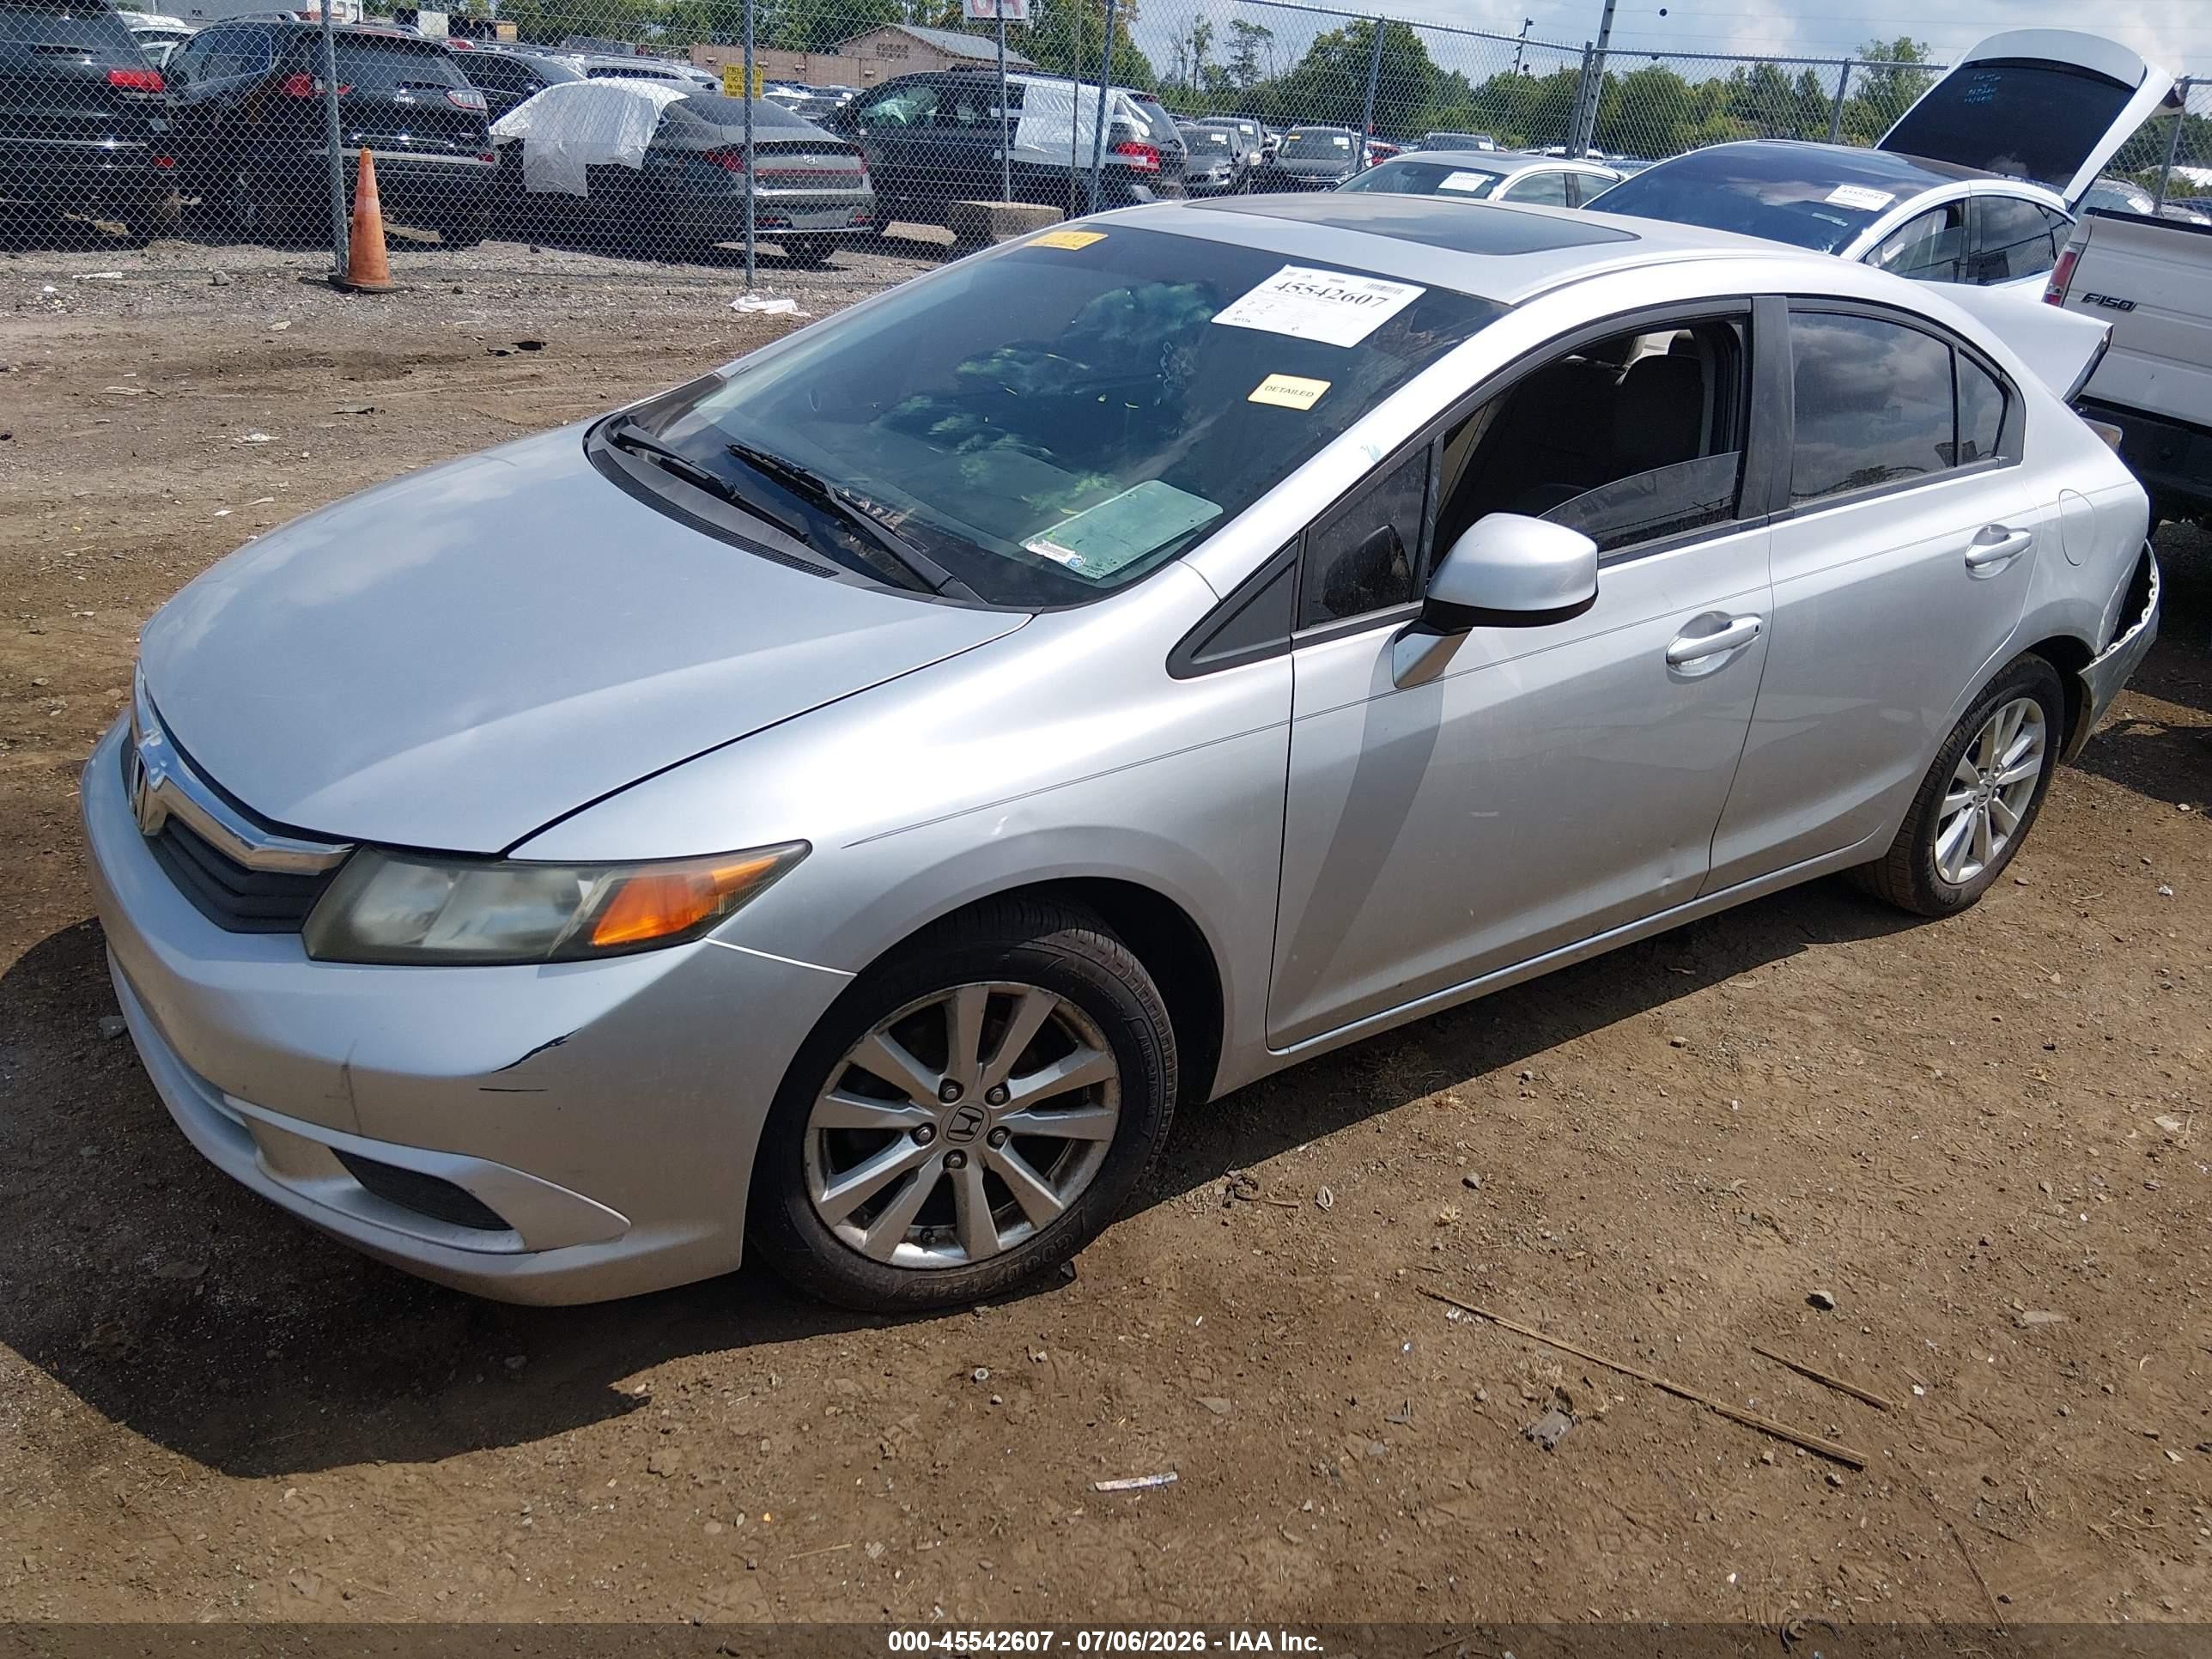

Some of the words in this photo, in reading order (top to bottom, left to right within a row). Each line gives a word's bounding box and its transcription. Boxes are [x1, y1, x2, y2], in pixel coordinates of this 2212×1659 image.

[392, 94, 416, 106] Jeep
[1273, 281, 1391, 309] 45542607
[1264, 385, 1315, 398] DETAILED
